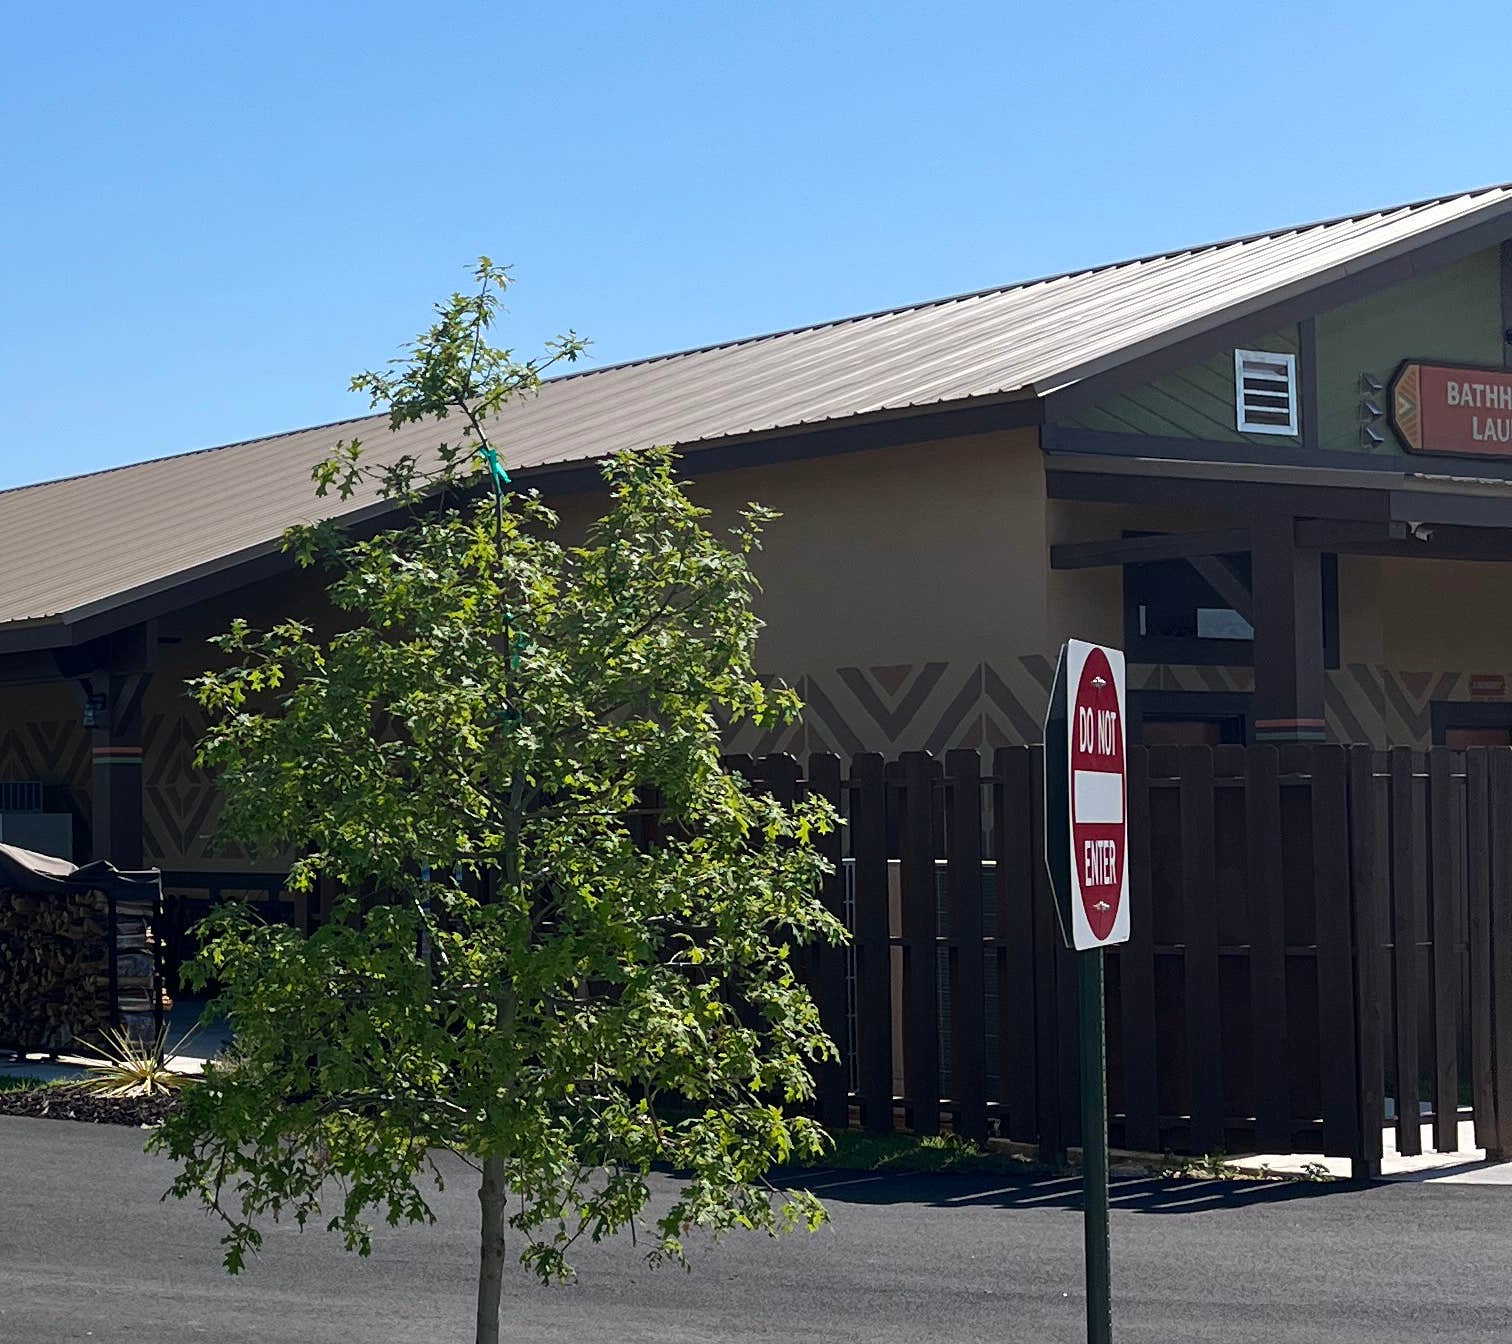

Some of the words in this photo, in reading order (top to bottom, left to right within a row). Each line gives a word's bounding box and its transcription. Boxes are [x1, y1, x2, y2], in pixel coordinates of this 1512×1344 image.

[1472, 416, 1512, 442] LAU
[1079, 706, 1094, 754] DO
[1098, 709, 1117, 756] NOT
[1084, 840, 1117, 886] ENTER
